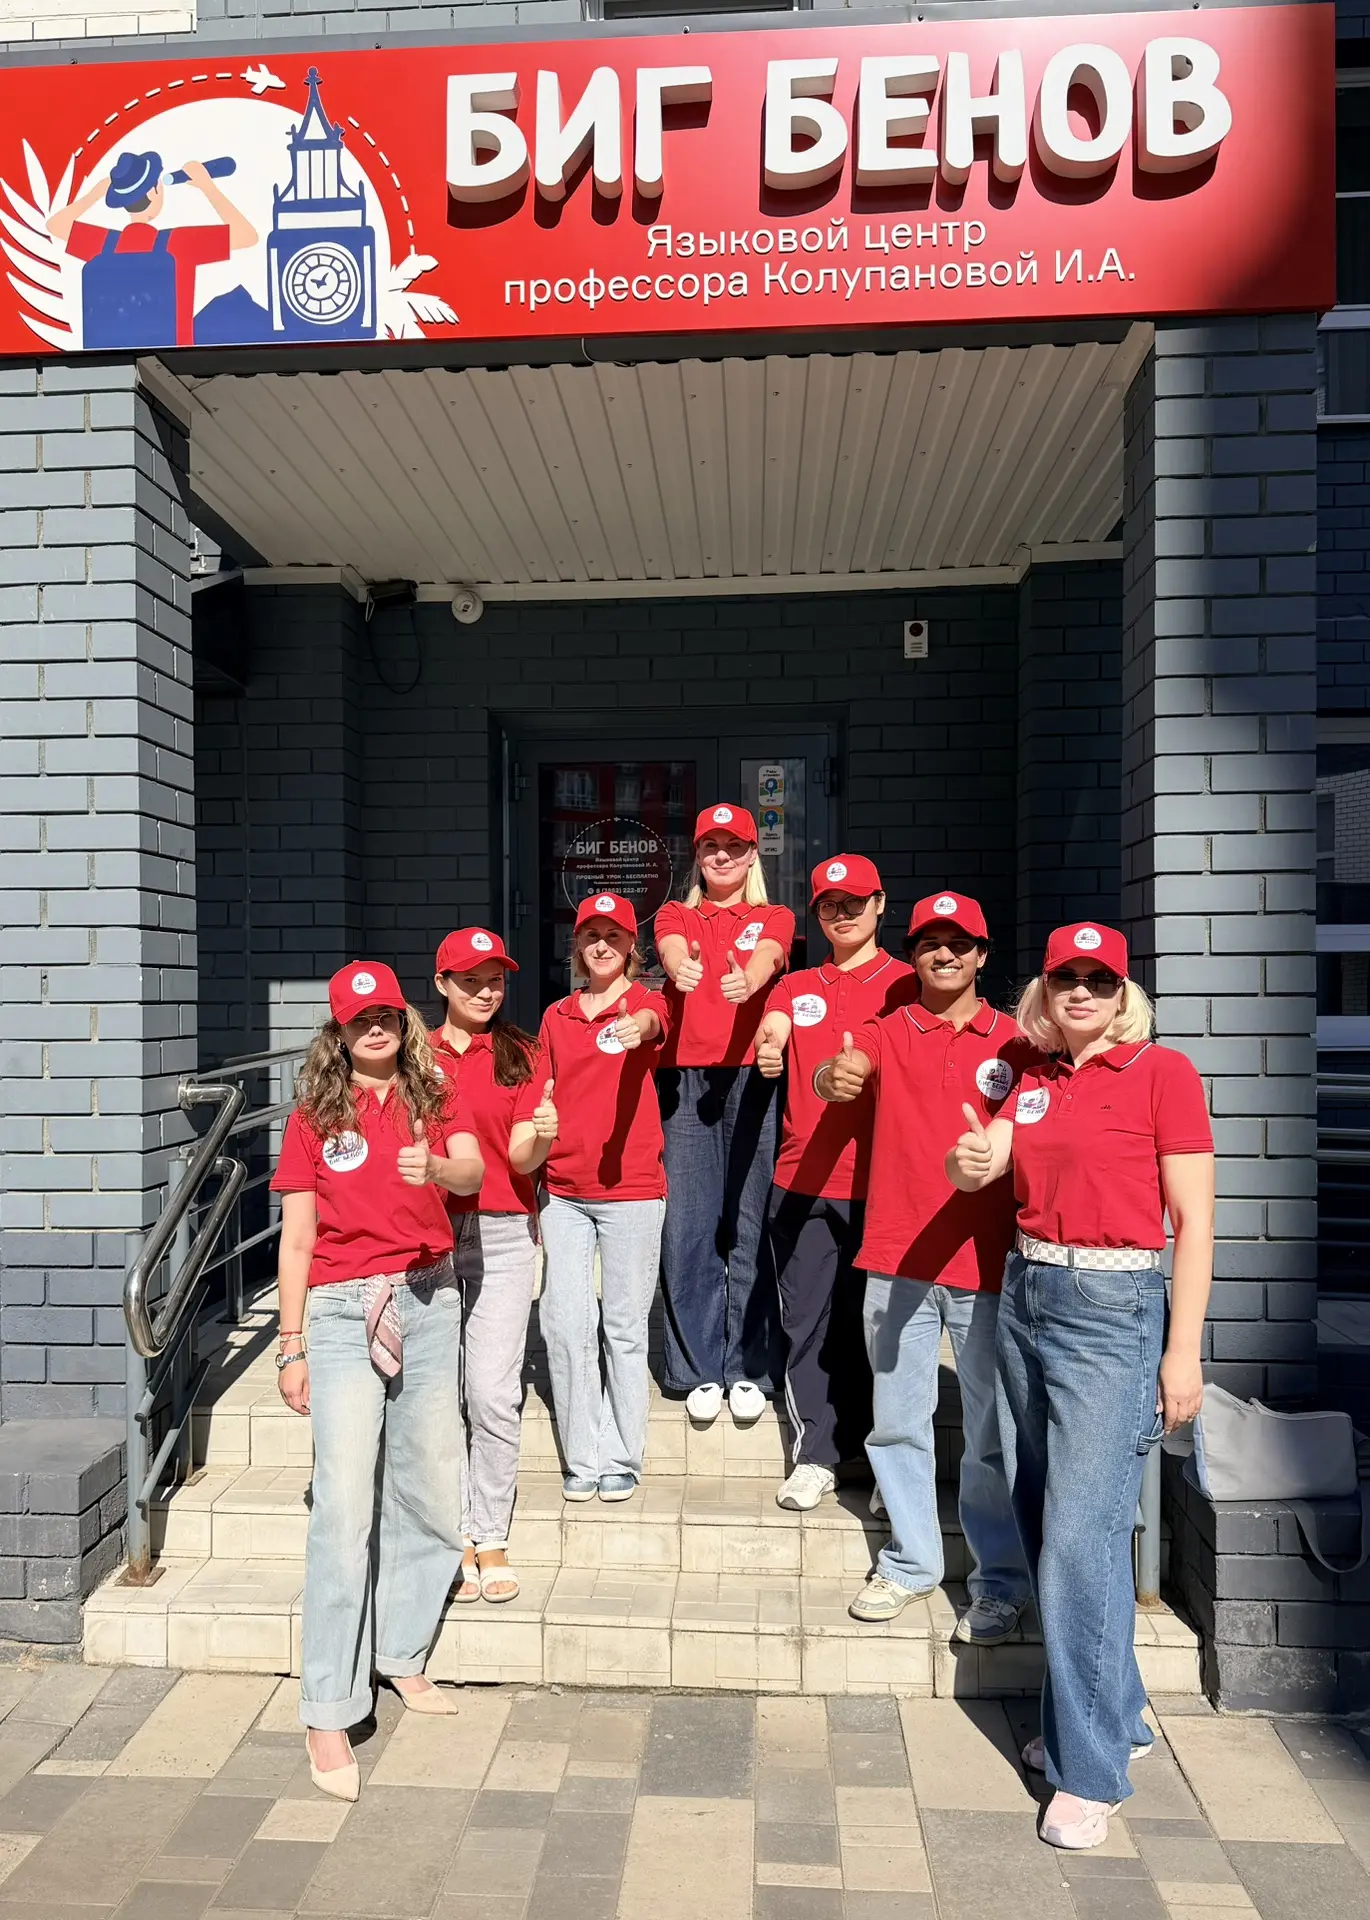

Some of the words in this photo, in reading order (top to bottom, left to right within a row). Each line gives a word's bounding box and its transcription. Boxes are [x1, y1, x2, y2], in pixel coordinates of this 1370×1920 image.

[446, 66, 713, 195] БИГ
[764, 37, 1232, 182] БЕНОВ
[647, 217, 849, 257] Языковой
[864, 220, 987, 254] центр
[504, 268, 749, 312] профессора
[764, 250, 1039, 301] Колупановой
[1054, 247, 1136, 284] И.А.
[576, 841, 605, 854] БИГ
[609, 840, 659, 854] БЕНОВ
